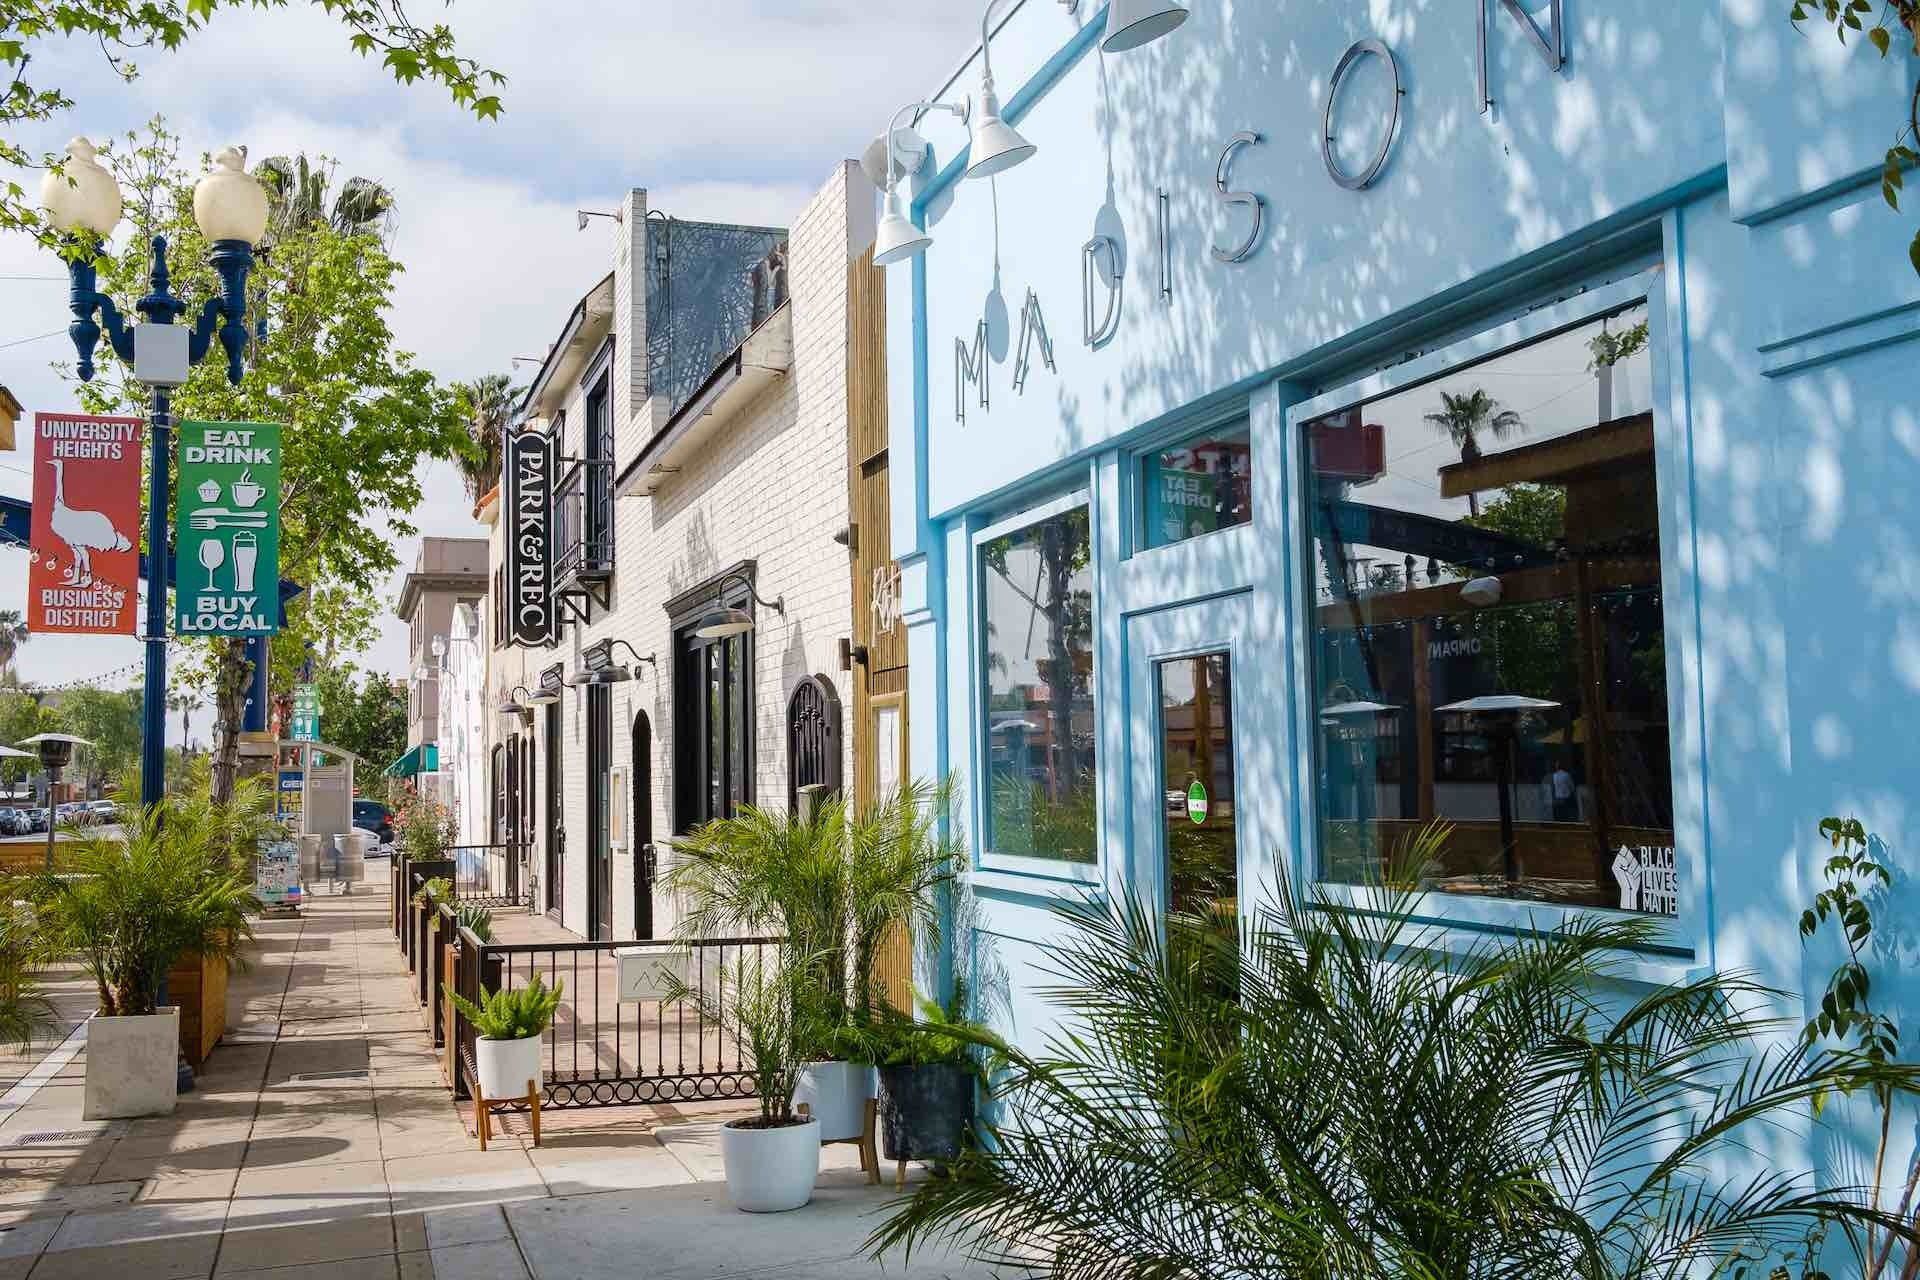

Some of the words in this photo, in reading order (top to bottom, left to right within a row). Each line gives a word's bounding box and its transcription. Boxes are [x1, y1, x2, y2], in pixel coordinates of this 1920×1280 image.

[956, 0, 1565, 424] MADISON
[41, 420, 136, 441] UNIVERSITY
[203, 430, 256, 447] EAT
[53, 440, 123, 460] HEIGHTS
[186, 447, 272, 464] DRINK
[41, 589, 125, 609] BUSINESS
[196, 596, 258, 613] BUY
[45, 609, 121, 629] DISTRICT
[182, 613, 272, 631] LOCAL
[1640, 846, 1676, 868] BLAC
[1643, 870, 1678, 892] LIVES
[1642, 891, 1678, 914] MATTE
